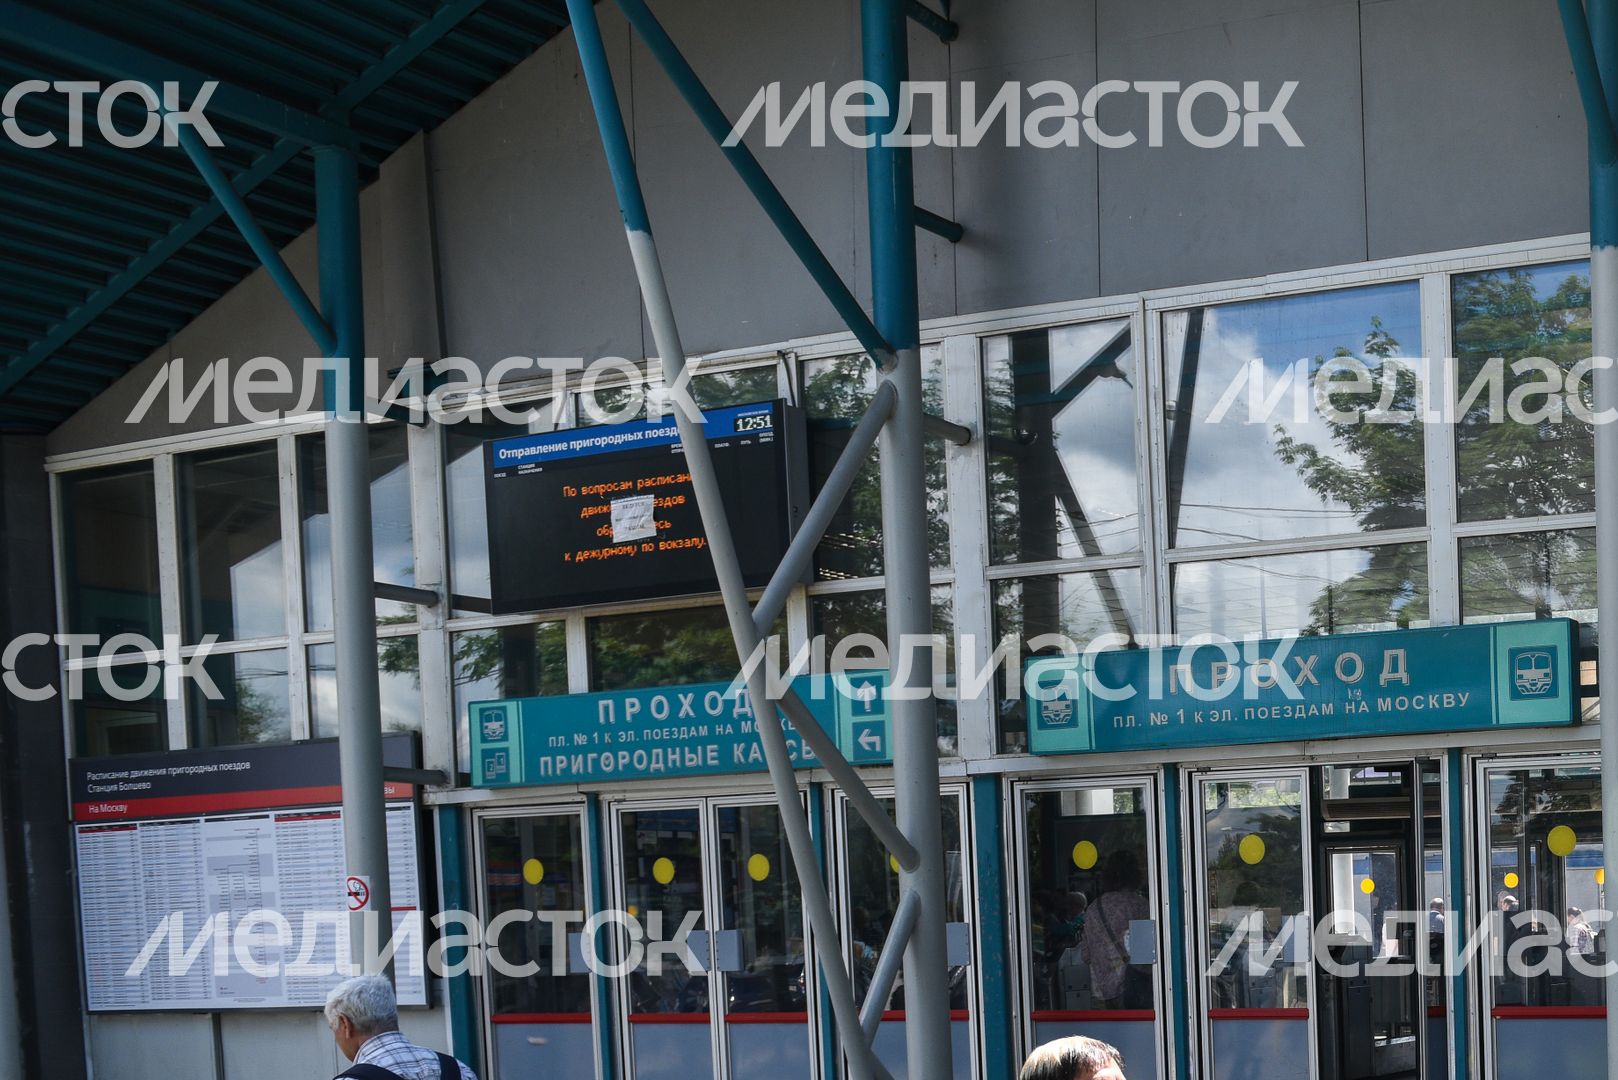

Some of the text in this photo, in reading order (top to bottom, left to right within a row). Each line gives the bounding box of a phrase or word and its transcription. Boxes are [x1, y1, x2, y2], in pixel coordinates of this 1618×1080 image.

[736, 414, 773, 432] 12:51
[498, 426, 680, 460] Отправление пригородных поезд
[563, 472, 692, 497] По вопросам расписан
[564, 537, 707, 563] к дежурному по вокзалу.
[1168, 648, 1411, 696] ПРОХОД
[597, 687, 753, 726] ПРОХОД
[1113, 692, 1471, 728] ПЛ. № 1 К ЭЛ. ПОЕЗДАМ НА МОСКВУ
[548, 734, 570, 748] ПЛ.
[573, 732, 589, 746] №
[592, 731, 599, 744] 1
[604, 732, 612, 744] К
[618, 729, 640, 743] ЭЛ.
[643, 725, 709, 742] ПОЕЗДАМ
[714, 723, 735, 736] НА
[86, 760, 251, 781] Расписание движения пригородных поездов
[539, 738, 817, 778] ПРИГОРОДНЫЕ КАСЫ
[87, 780, 152, 794] Станция Болшево
[88, 803, 128, 814] На Москву
